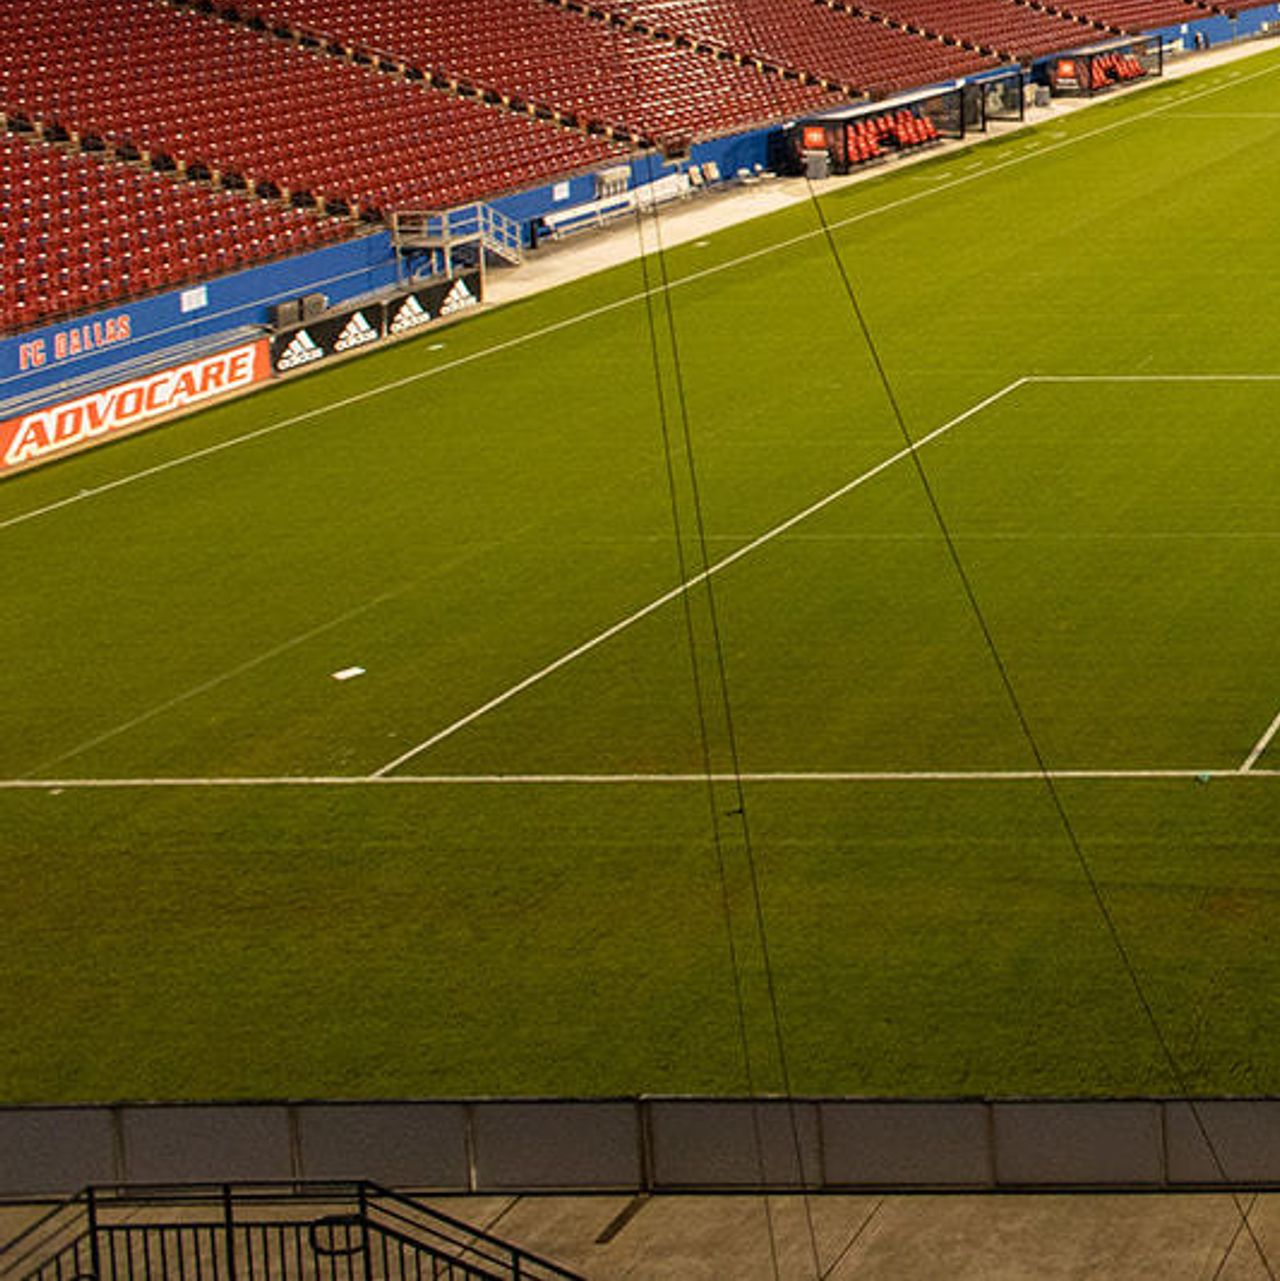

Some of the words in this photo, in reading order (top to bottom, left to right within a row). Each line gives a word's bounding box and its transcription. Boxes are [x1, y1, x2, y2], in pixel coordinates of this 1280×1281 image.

[389, 311, 432, 334] adidas
[19, 338, 46, 371] FC
[54, 314, 131, 360] DALLAS
[333, 328, 379, 353] adidas
[276, 346, 325, 371] adidas
[6, 346, 255, 464] ADVOCARE
